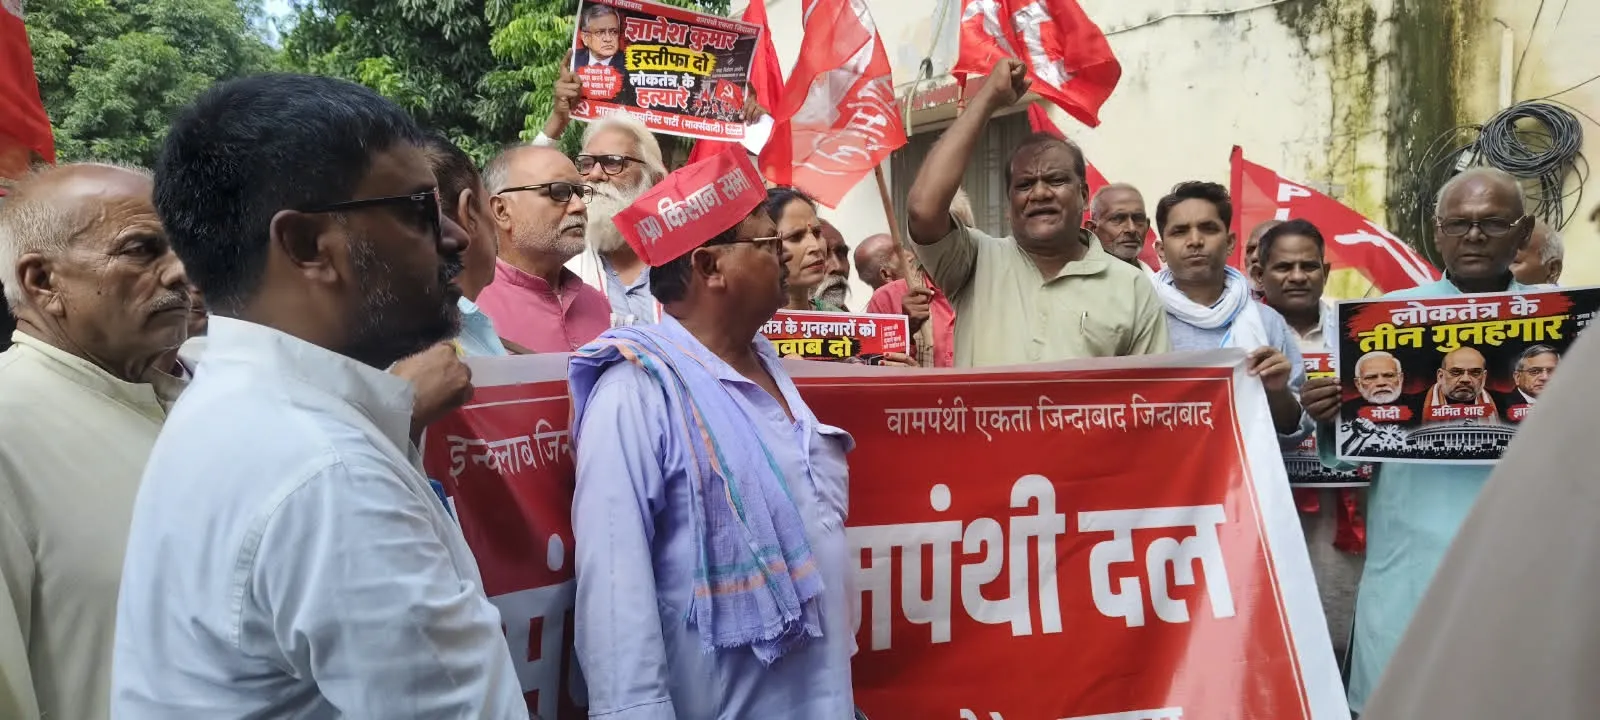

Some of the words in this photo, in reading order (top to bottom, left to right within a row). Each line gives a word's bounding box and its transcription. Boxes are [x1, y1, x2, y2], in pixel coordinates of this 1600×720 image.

[625, 16, 688, 45] ज्ञानेश
[689, 26, 739, 51] कुमार
[631, 47, 689, 68] इस्तीफा
[692, 53, 709, 72] दो
[629, 71, 678, 88] लोकतंत्र
[681, 74, 695, 88] के
[636, 86, 692, 109] हत्यारे
[663, 116, 679, 128] पार्टी
[657, 182, 724, 232] किसान
[717, 166, 751, 201] सभा
[1389, 299, 1501, 327] लोकतंत्र
[1509, 296, 1541, 317] के
[785, 317, 798, 334] के
[801, 319, 857, 338] गुनहगारों
[859, 320, 876, 337] को
[1358, 324, 1425, 353] तीन
[1431, 315, 1569, 353] गुनहगार
[828, 336, 852, 357] दो
[885, 399, 968, 435] वामपंथी
[973, 405, 1032, 441] एकता
[1037, 396, 1127, 432] जिन्दाबाद
[1131, 394, 1214, 430] जिन्दाबाद
[1371, 406, 1400, 419] मोदी
[1432, 405, 1461, 417] अमित
[1464, 405, 1485, 417] शाह
[847, 474, 1065, 651] मपंथी
[1078, 503, 1236, 628] दल
